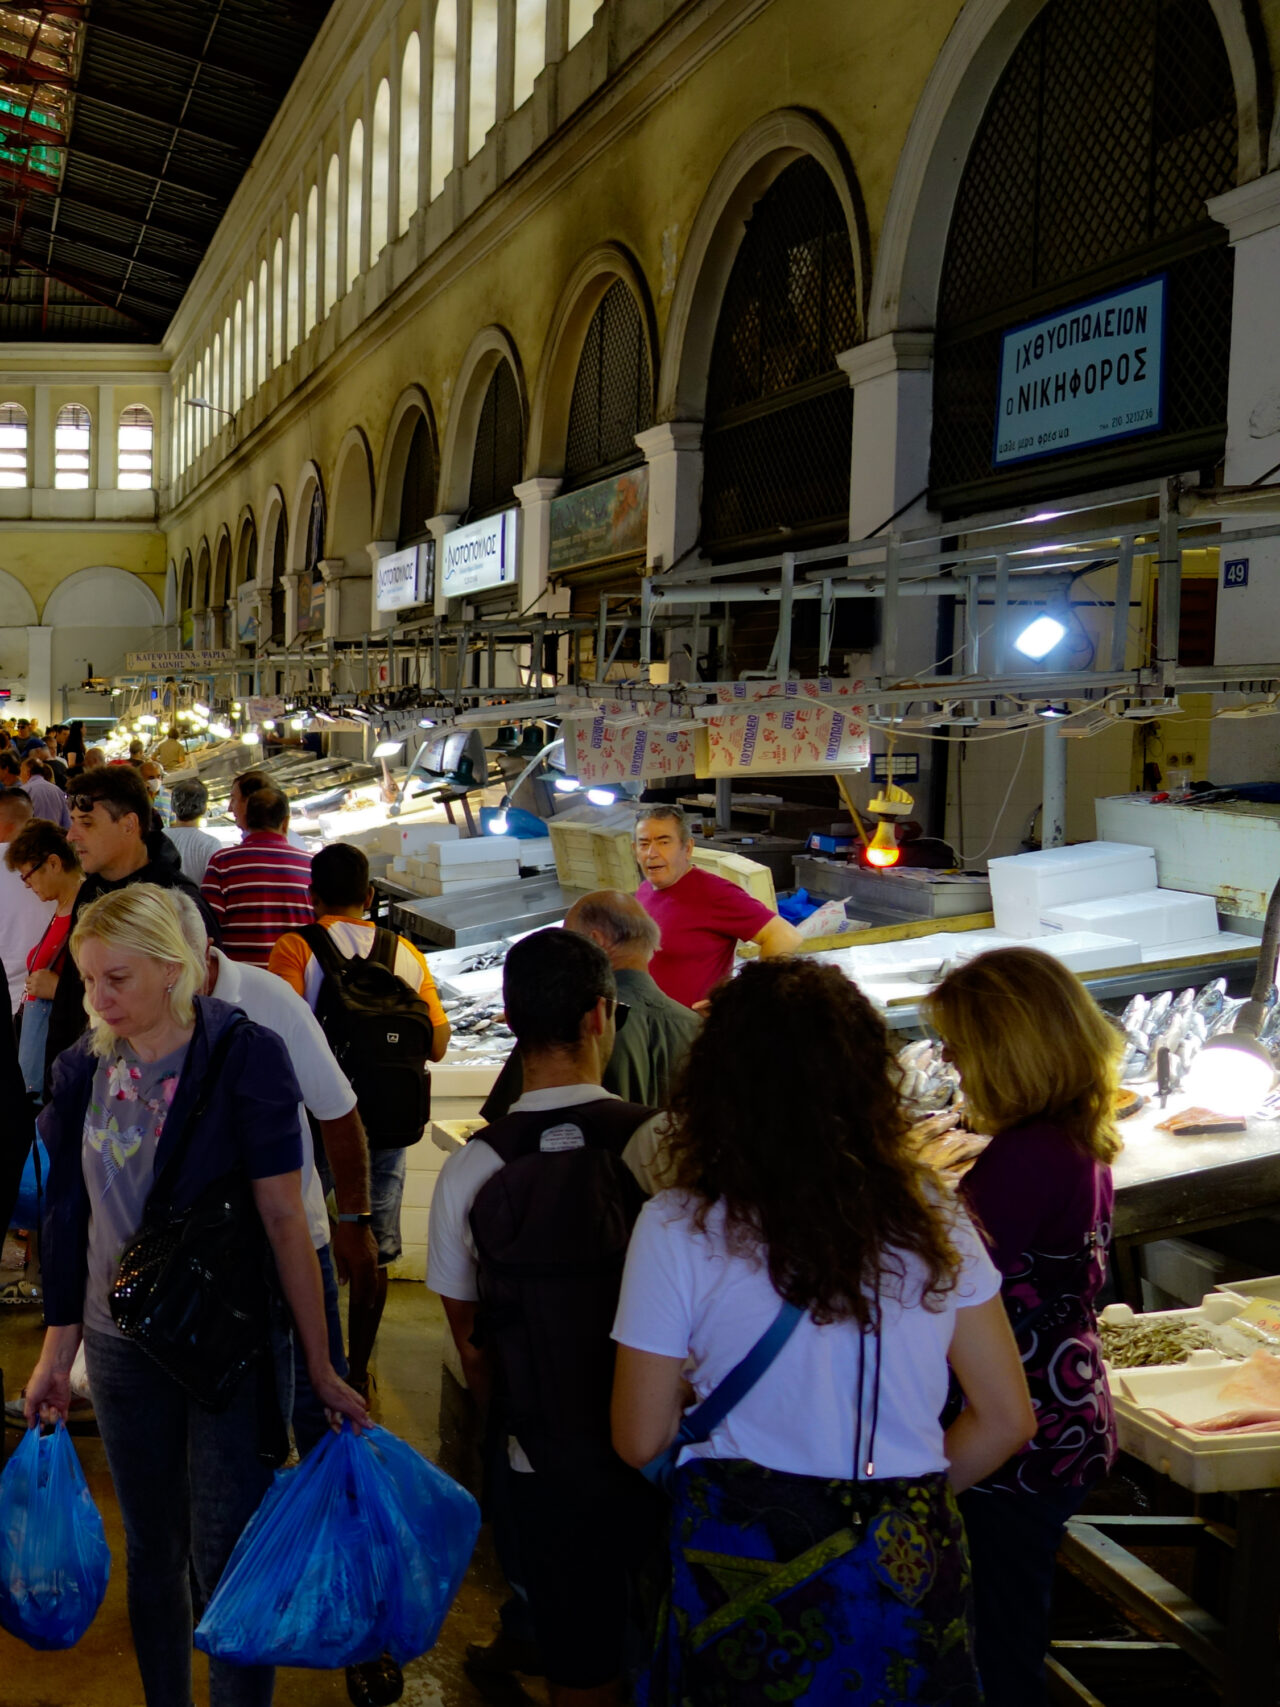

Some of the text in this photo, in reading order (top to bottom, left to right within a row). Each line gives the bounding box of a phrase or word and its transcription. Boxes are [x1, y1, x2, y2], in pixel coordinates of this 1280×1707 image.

[1016, 305, 1148, 374] ΙΧΘΥΟΠΩΛΕΙΟΝ
[1017, 346, 1148, 414] ΝΙΚΗΦΟΡΟΣ
[1227, 564, 1245, 583] 49
